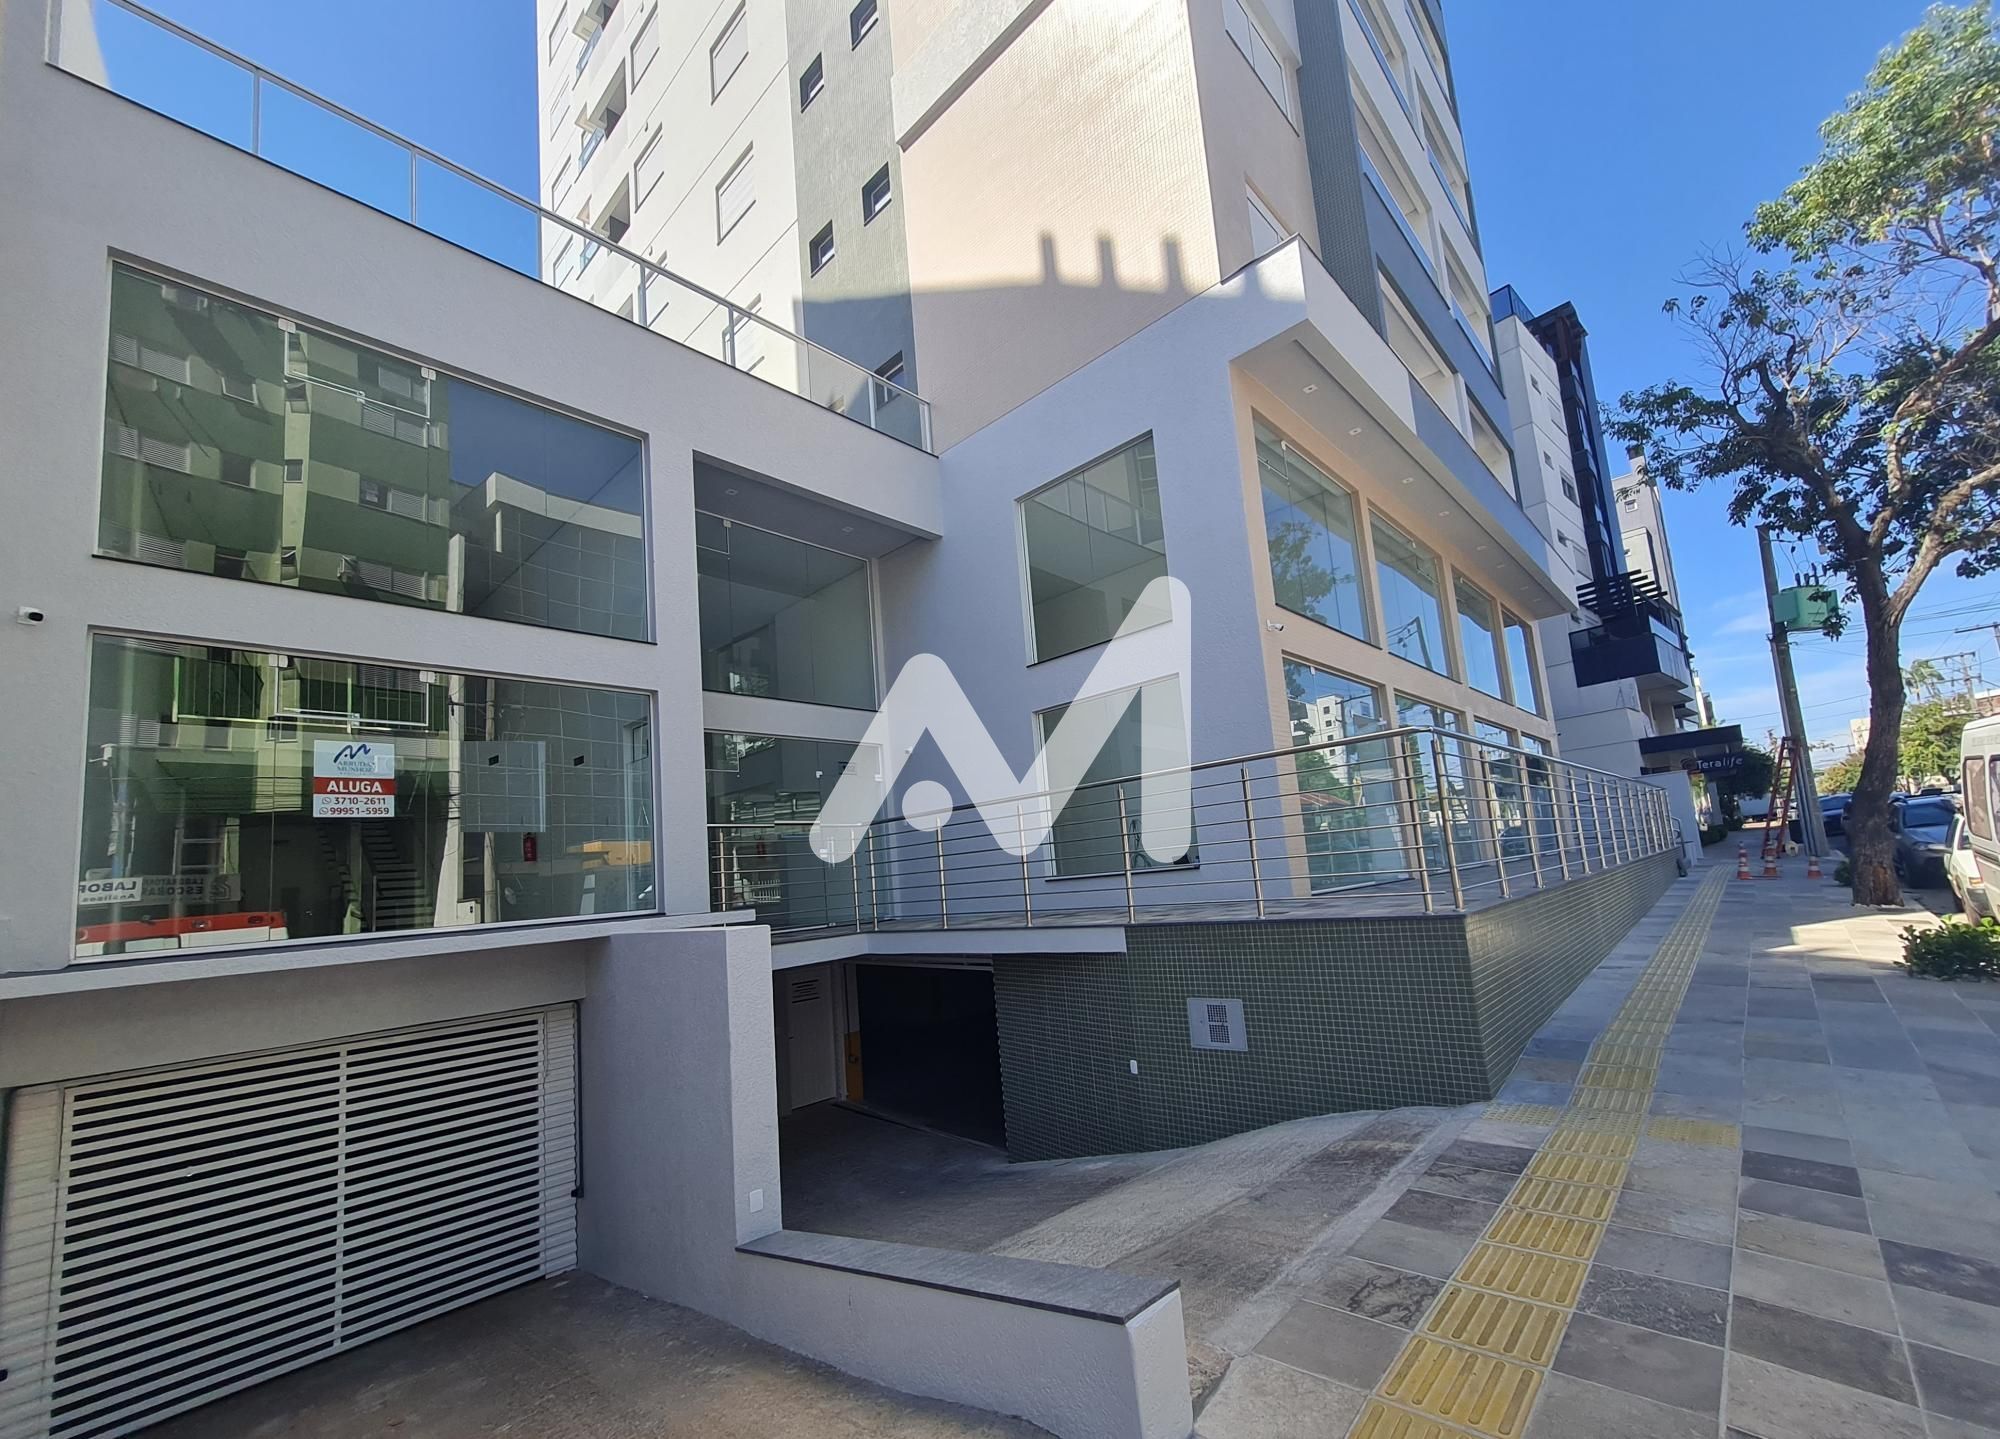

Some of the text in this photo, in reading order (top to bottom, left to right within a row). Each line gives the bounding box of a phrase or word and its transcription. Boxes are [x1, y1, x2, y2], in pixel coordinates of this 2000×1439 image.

[1696, 757, 1743, 770] Teralife
[326, 780, 383, 794] ALUGA
[334, 797, 386, 805] 3710-2611
[330, 807, 389, 815] 99951-5959
